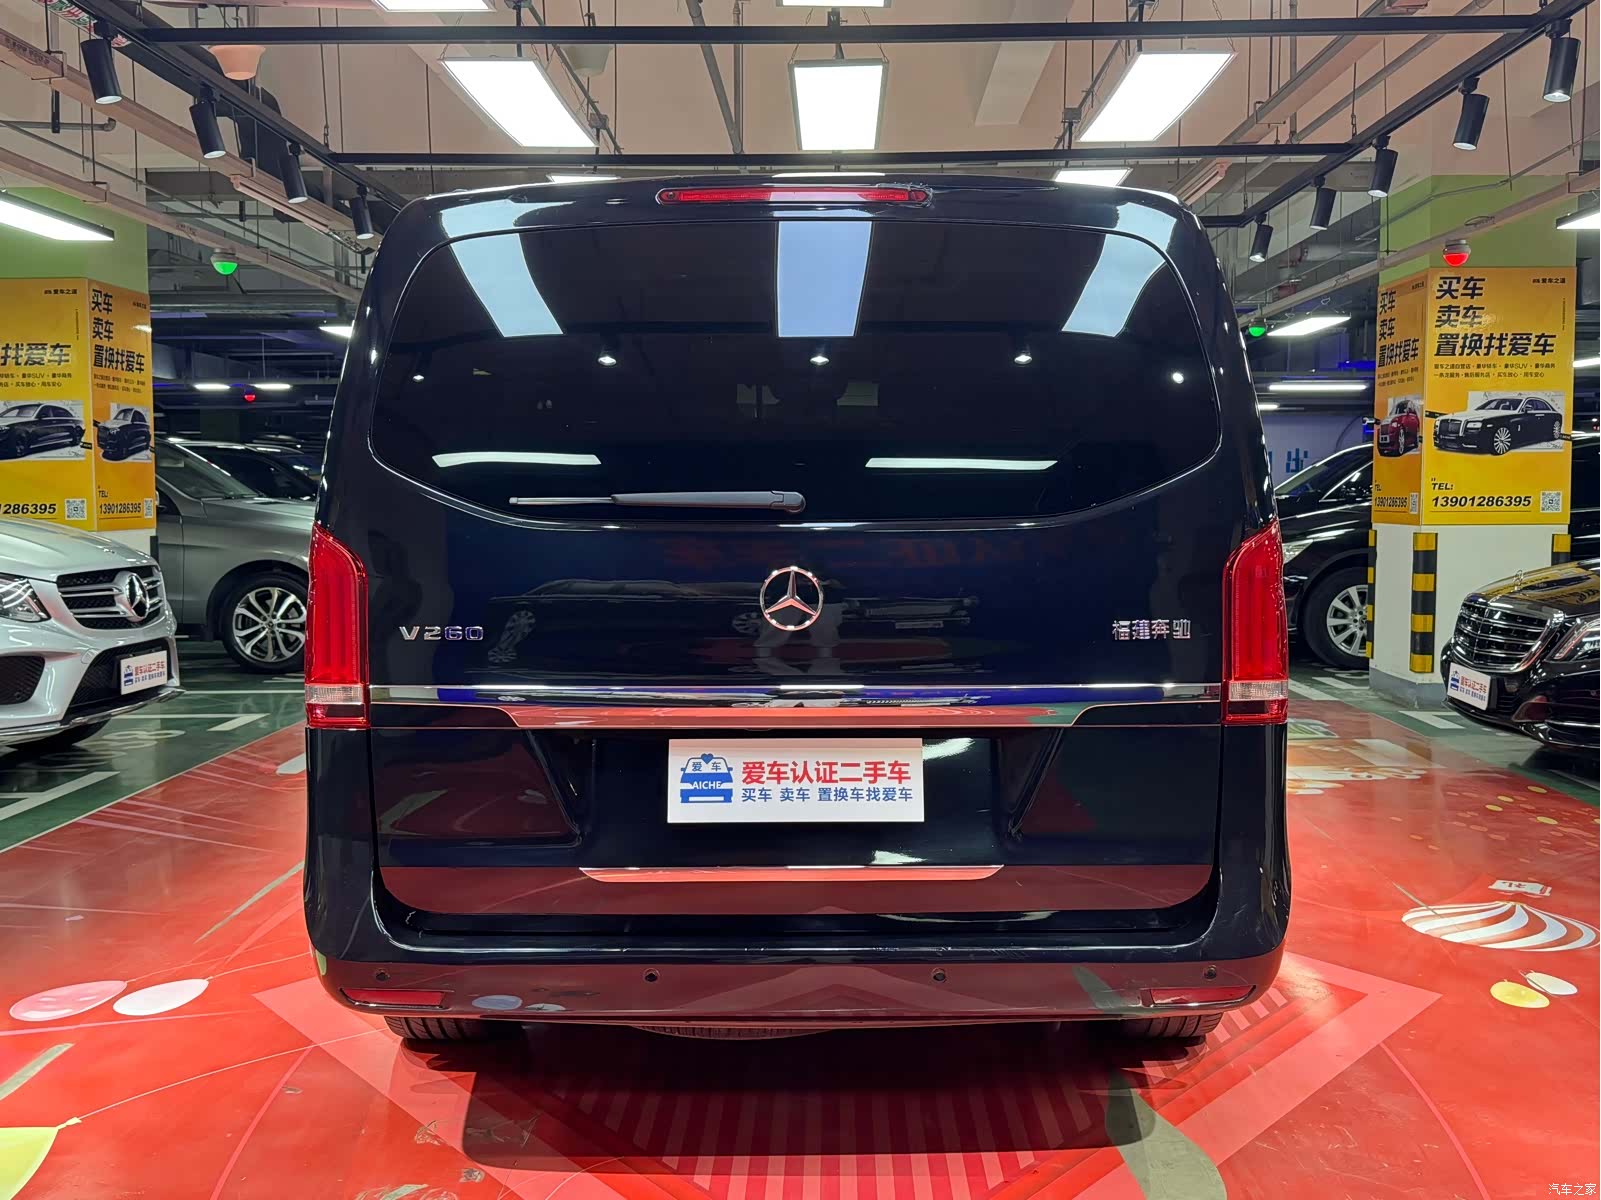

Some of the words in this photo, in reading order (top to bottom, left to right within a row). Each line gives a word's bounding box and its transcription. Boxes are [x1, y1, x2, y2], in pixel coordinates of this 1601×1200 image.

[1436, 276, 1486, 300] 买车
[92, 288, 113, 315] 买车
[1379, 290, 1397, 315] 买车
[1434, 305, 1486, 328] 卖车
[92, 317, 114, 342] 卖车
[1379, 317, 1396, 342] 卖车
[0, 343, 71, 366] 找爱车
[1378, 338, 1420, 368] 置换找爱车
[1433, 333, 1557, 357] 置换找爱车
[93, 344, 145, 374] 置换找爱车
[1432, 482, 1454, 490] TEL:
[0, 503, 57, 515] 286395
[99, 503, 142, 514] 13901286395
[1432, 496, 1531, 507] 13901286395
[399, 626, 484, 641] V260
[1112, 619, 1191, 640] 福建奔驰
[691, 761, 703, 772] 爱
[711, 761, 722, 772] 车
[741, 760, 912, 784] 爱车认证二手车
[692, 781, 722, 790] AICHE
[741, 787, 772, 802] 买车
[779, 787, 811, 802] 卖车
[817, 786, 913, 802] 置换车找爱车
